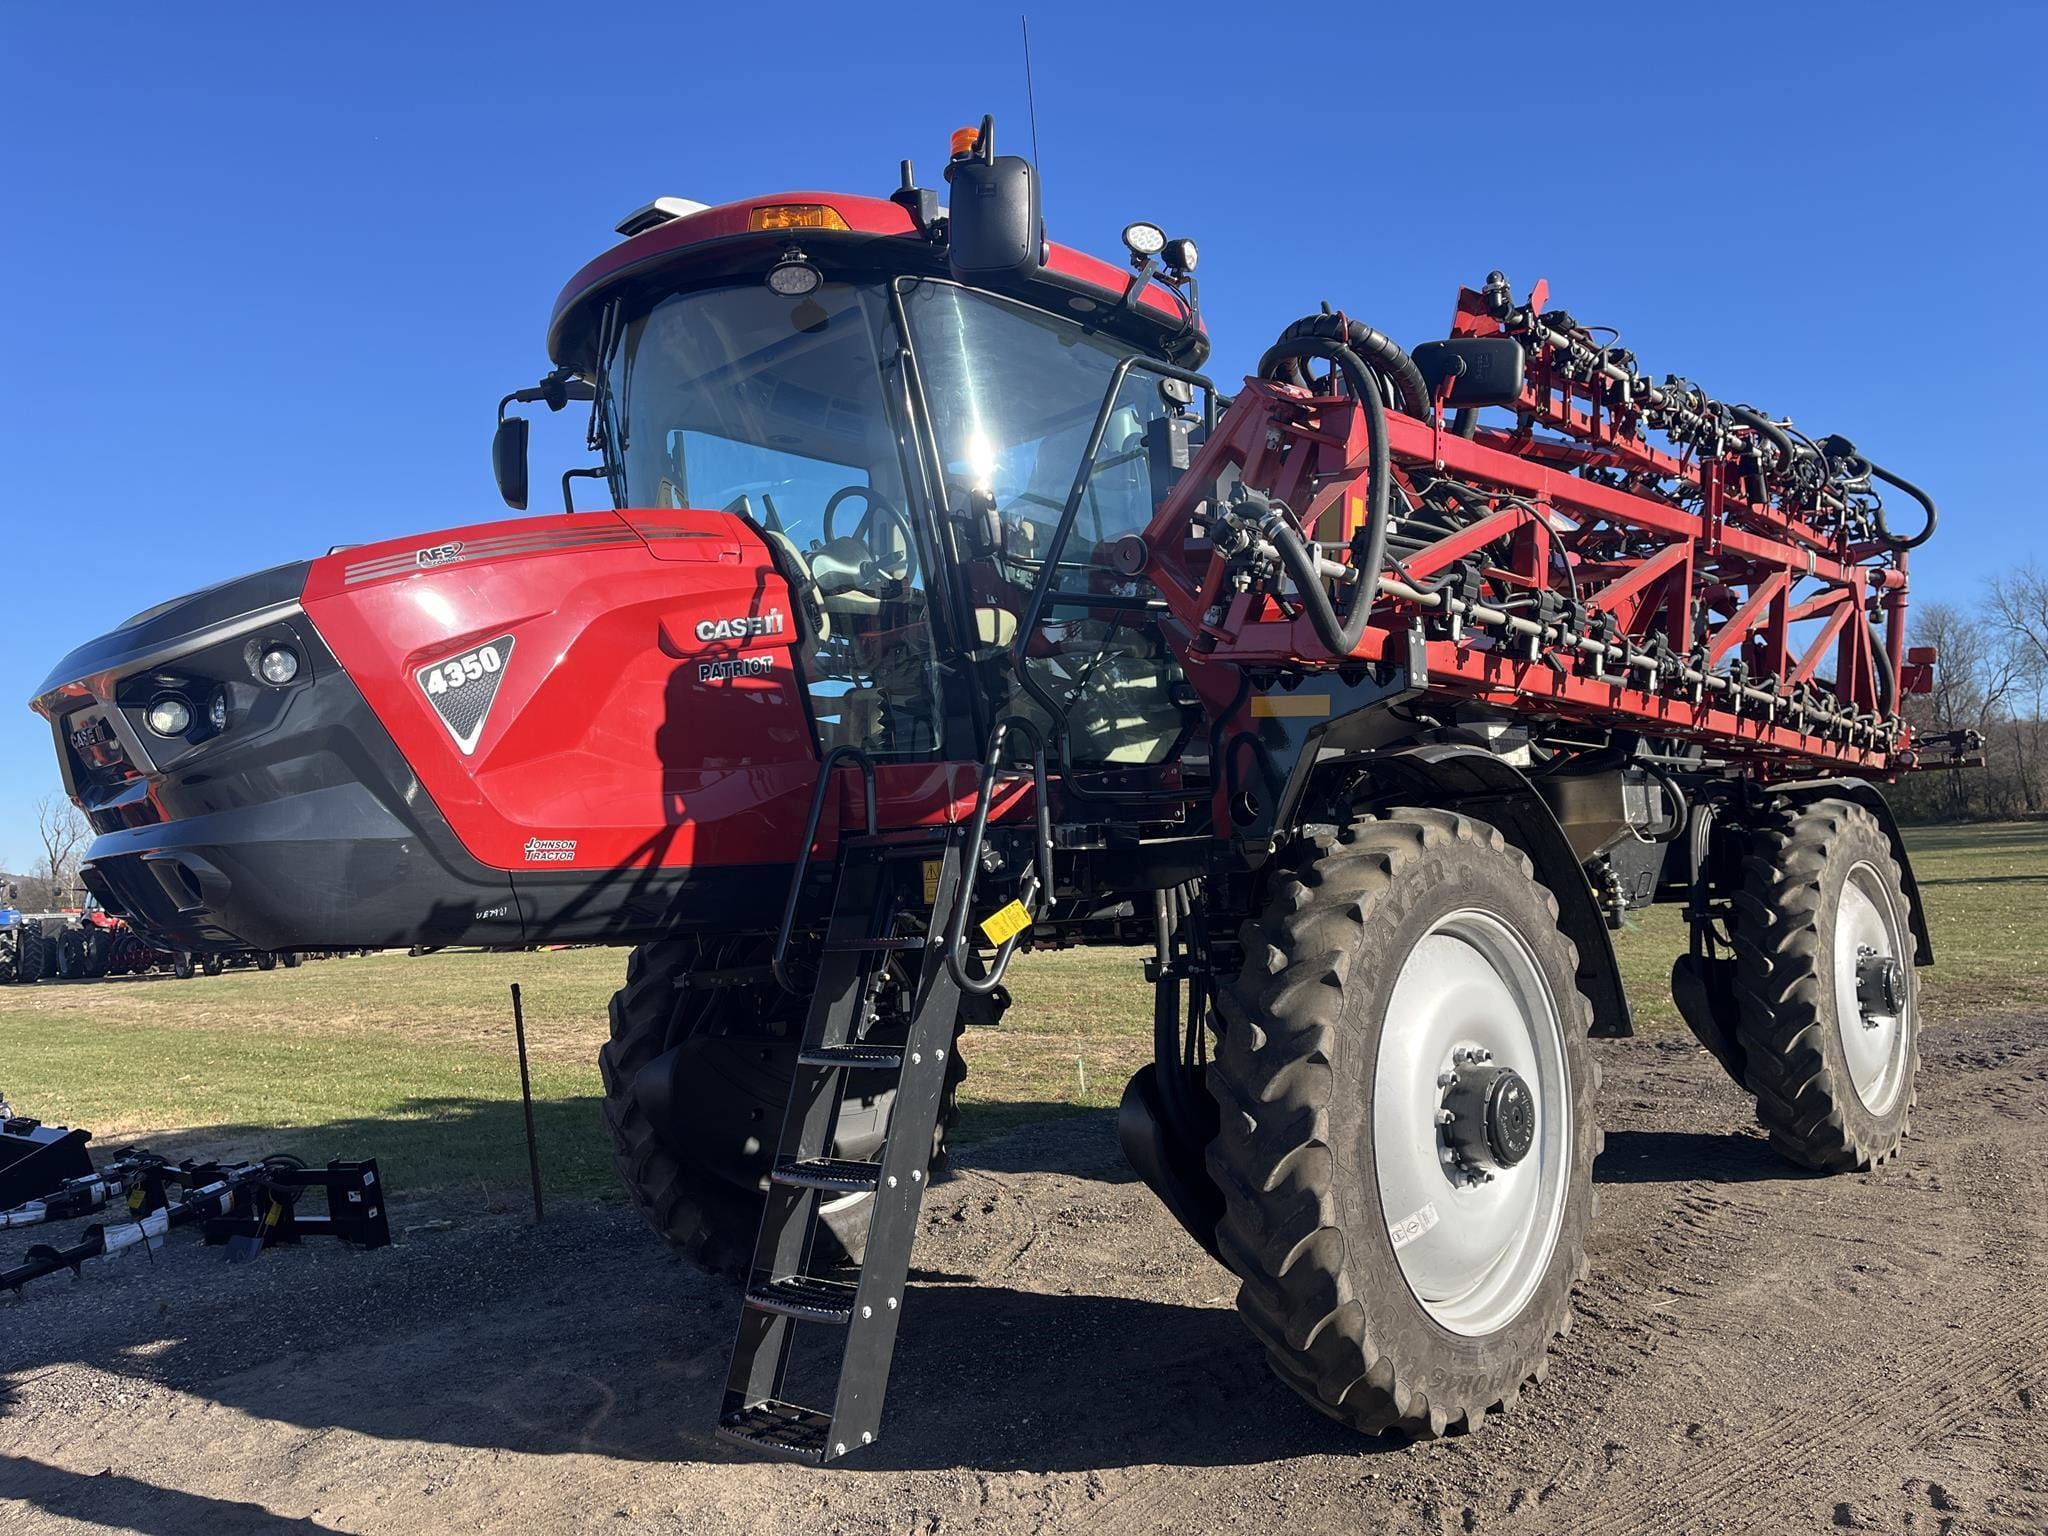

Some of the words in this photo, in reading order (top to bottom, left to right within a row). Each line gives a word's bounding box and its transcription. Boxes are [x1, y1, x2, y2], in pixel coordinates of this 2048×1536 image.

[417, 543, 456, 564] AFS
[427, 645, 501, 695] 4350
[698, 656, 774, 682] PATRIOT
[524, 837, 577, 850] JOHNSON
[524, 849, 576, 861] TRACTOR
